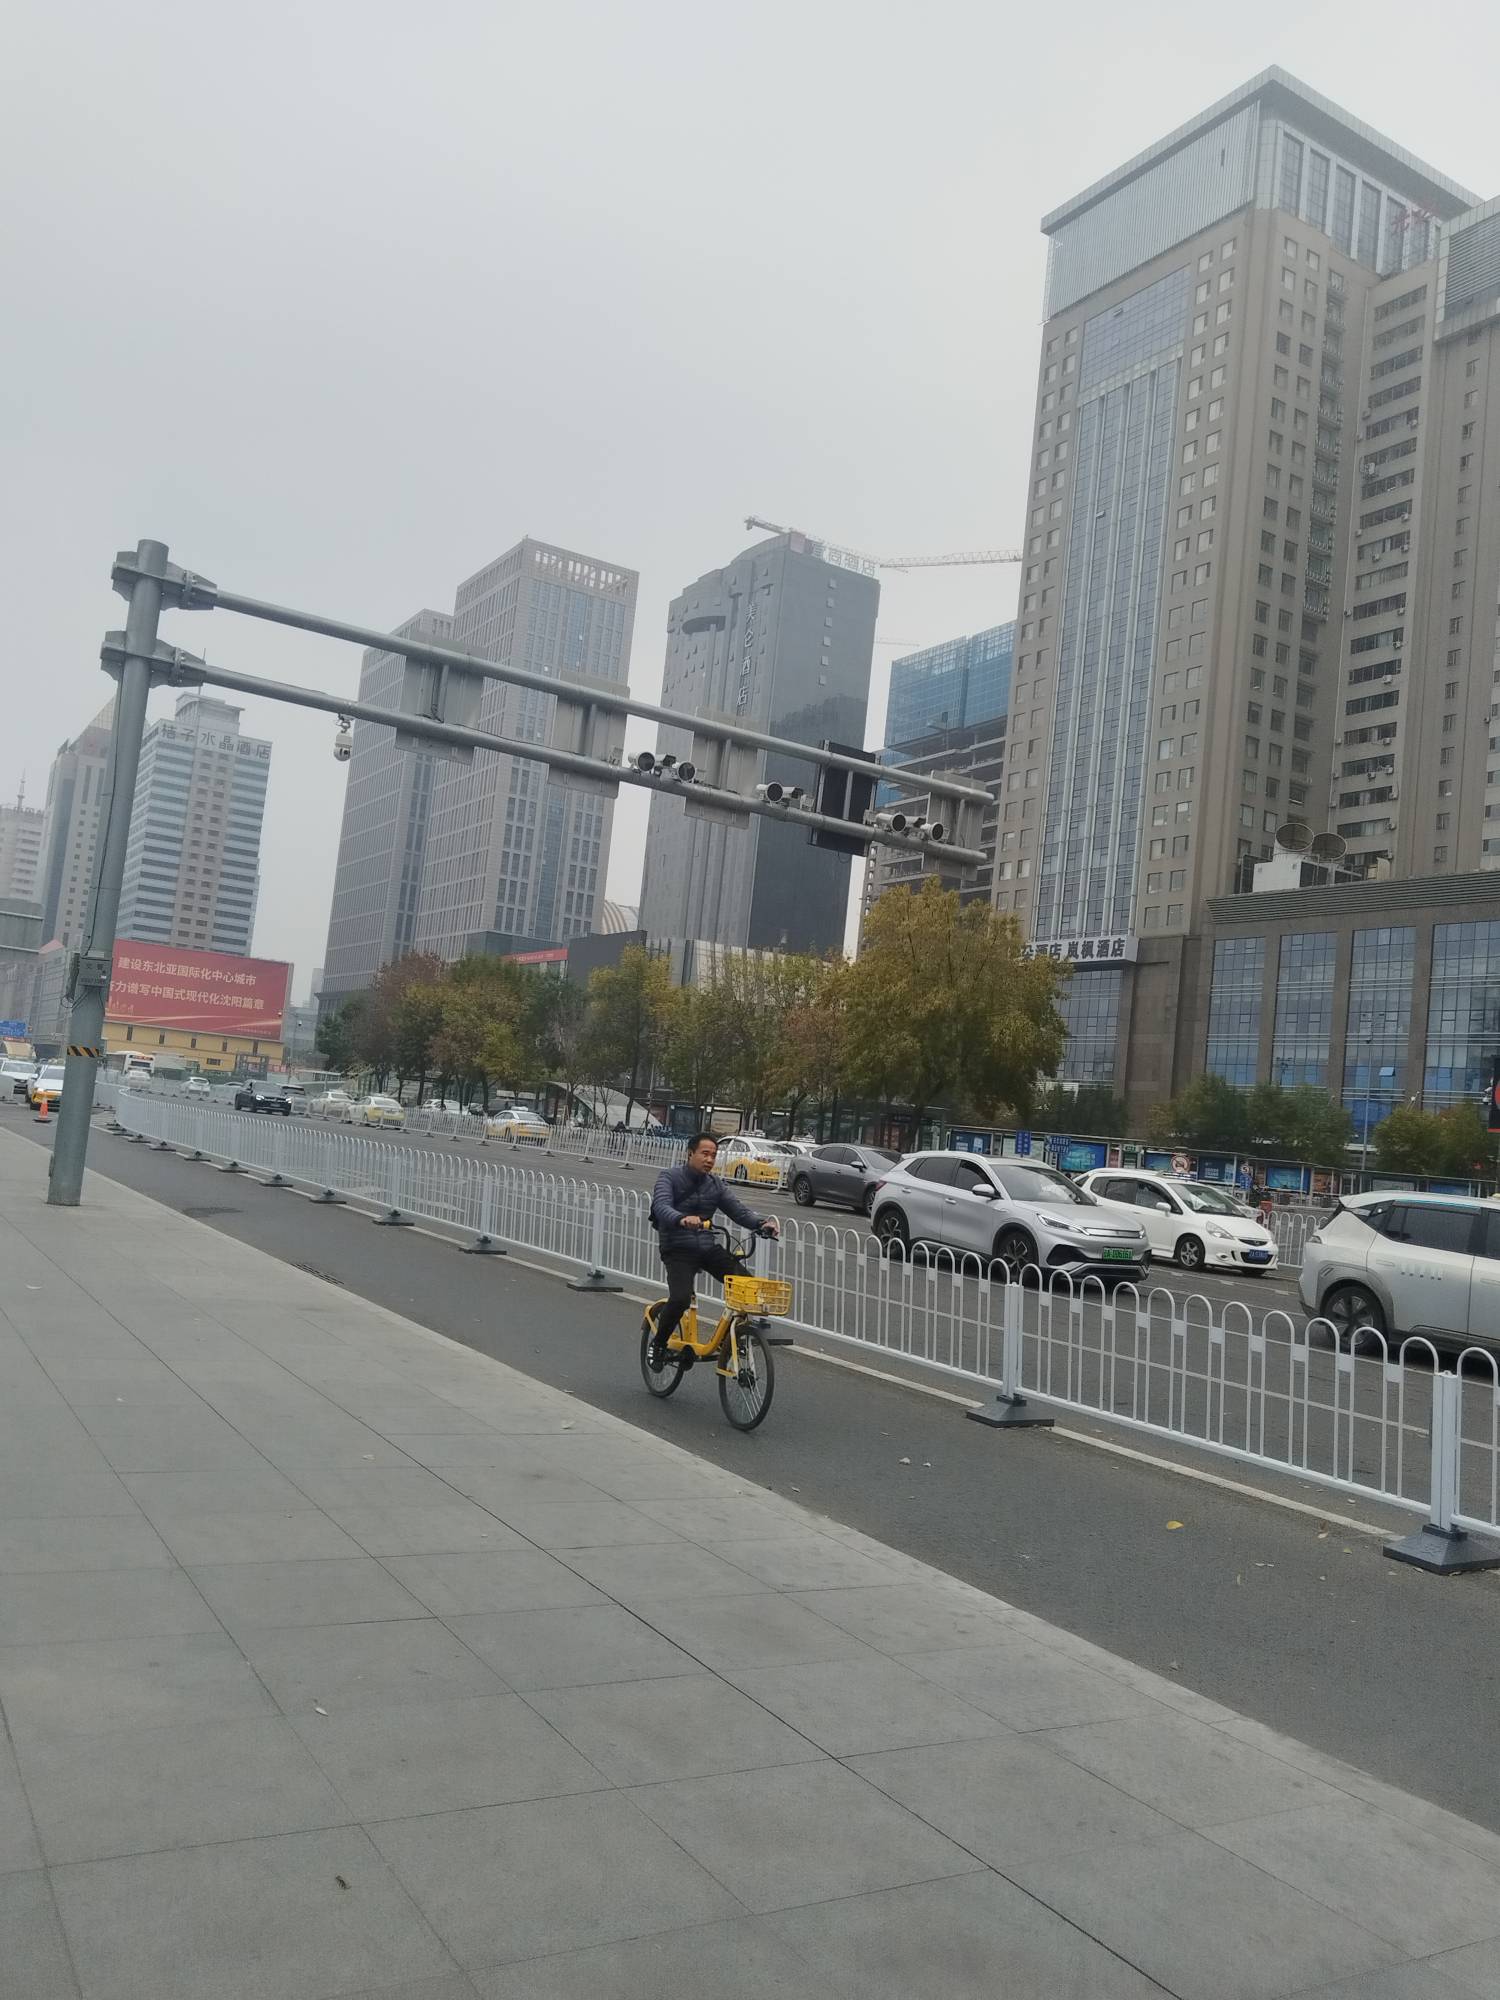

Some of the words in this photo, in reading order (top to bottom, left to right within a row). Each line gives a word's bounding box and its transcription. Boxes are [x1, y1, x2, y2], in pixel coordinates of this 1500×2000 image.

[161, 724, 271, 760] 桔子水晶酒店
[117, 956, 257, 987] 建设东北亚国际化中心城市
